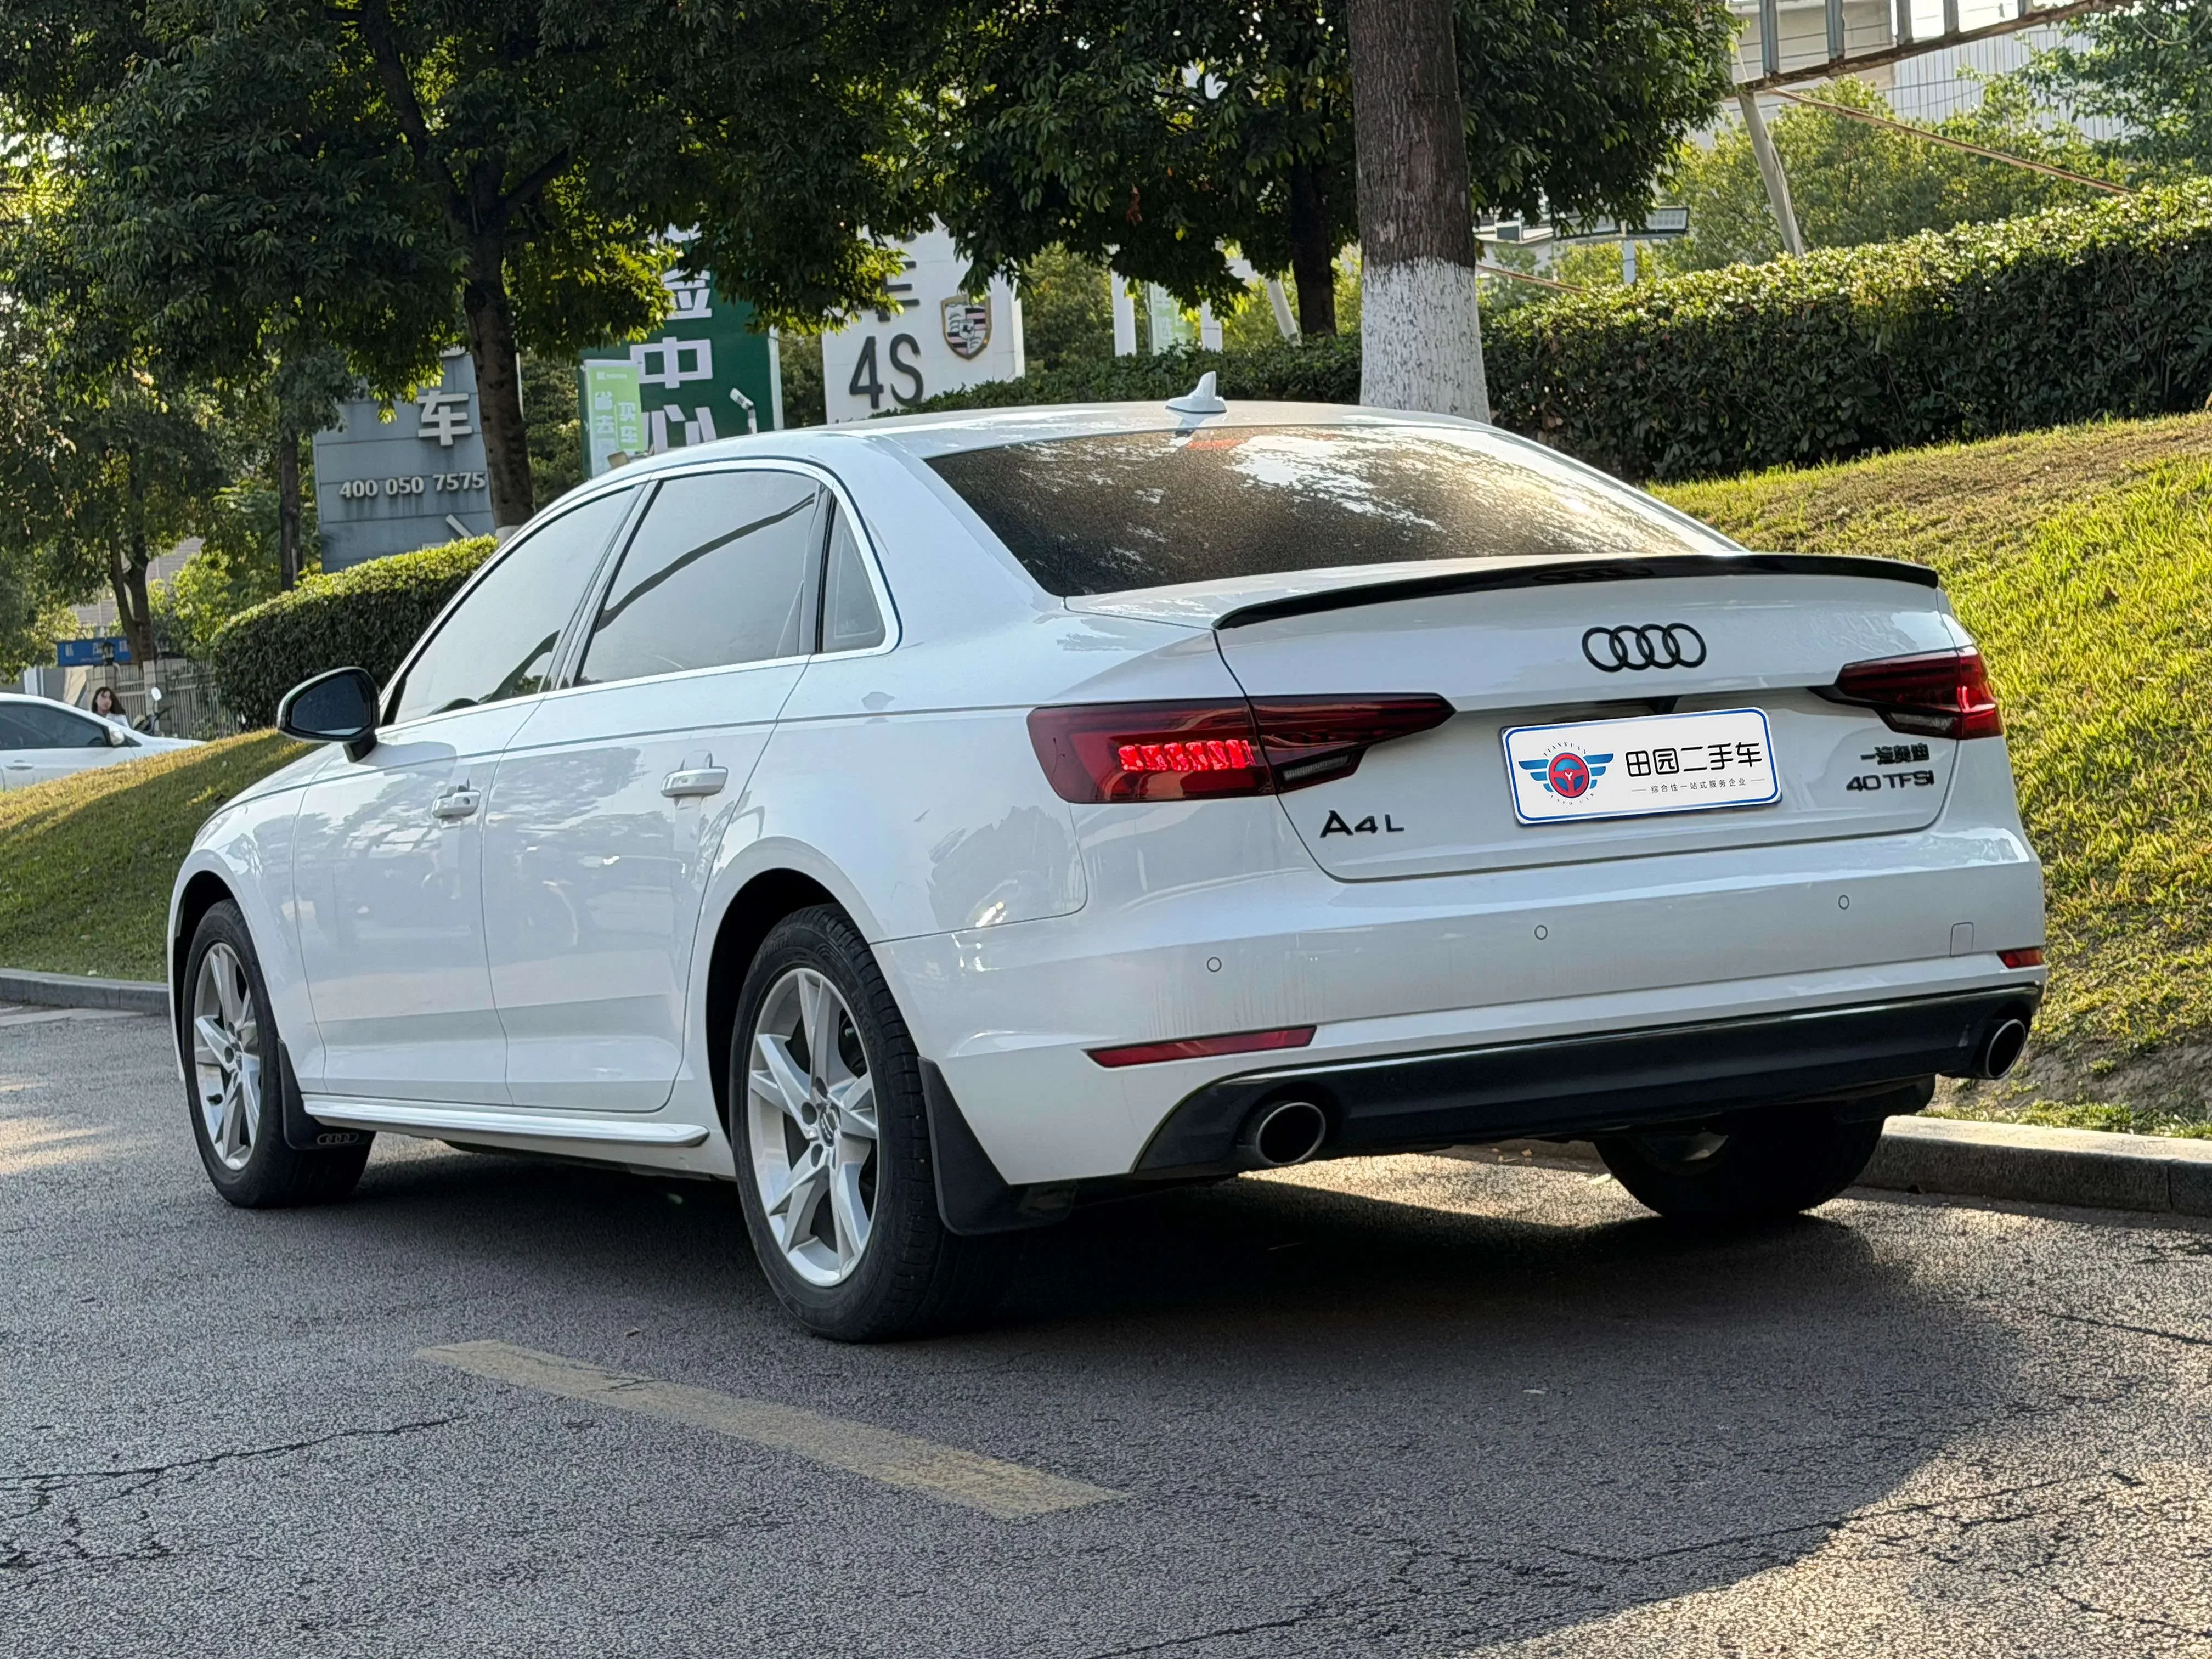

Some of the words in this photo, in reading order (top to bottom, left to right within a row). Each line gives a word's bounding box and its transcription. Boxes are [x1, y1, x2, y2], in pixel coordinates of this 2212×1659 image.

[849, 332, 924, 409] 4S
[416, 390, 473, 447] 车
[339, 479, 379, 498] 400
[385, 476, 425, 495] 050
[432, 472, 486, 492] 7575
[1846, 775, 1881, 792] 40
[1882, 770, 1934, 789] TFSI
